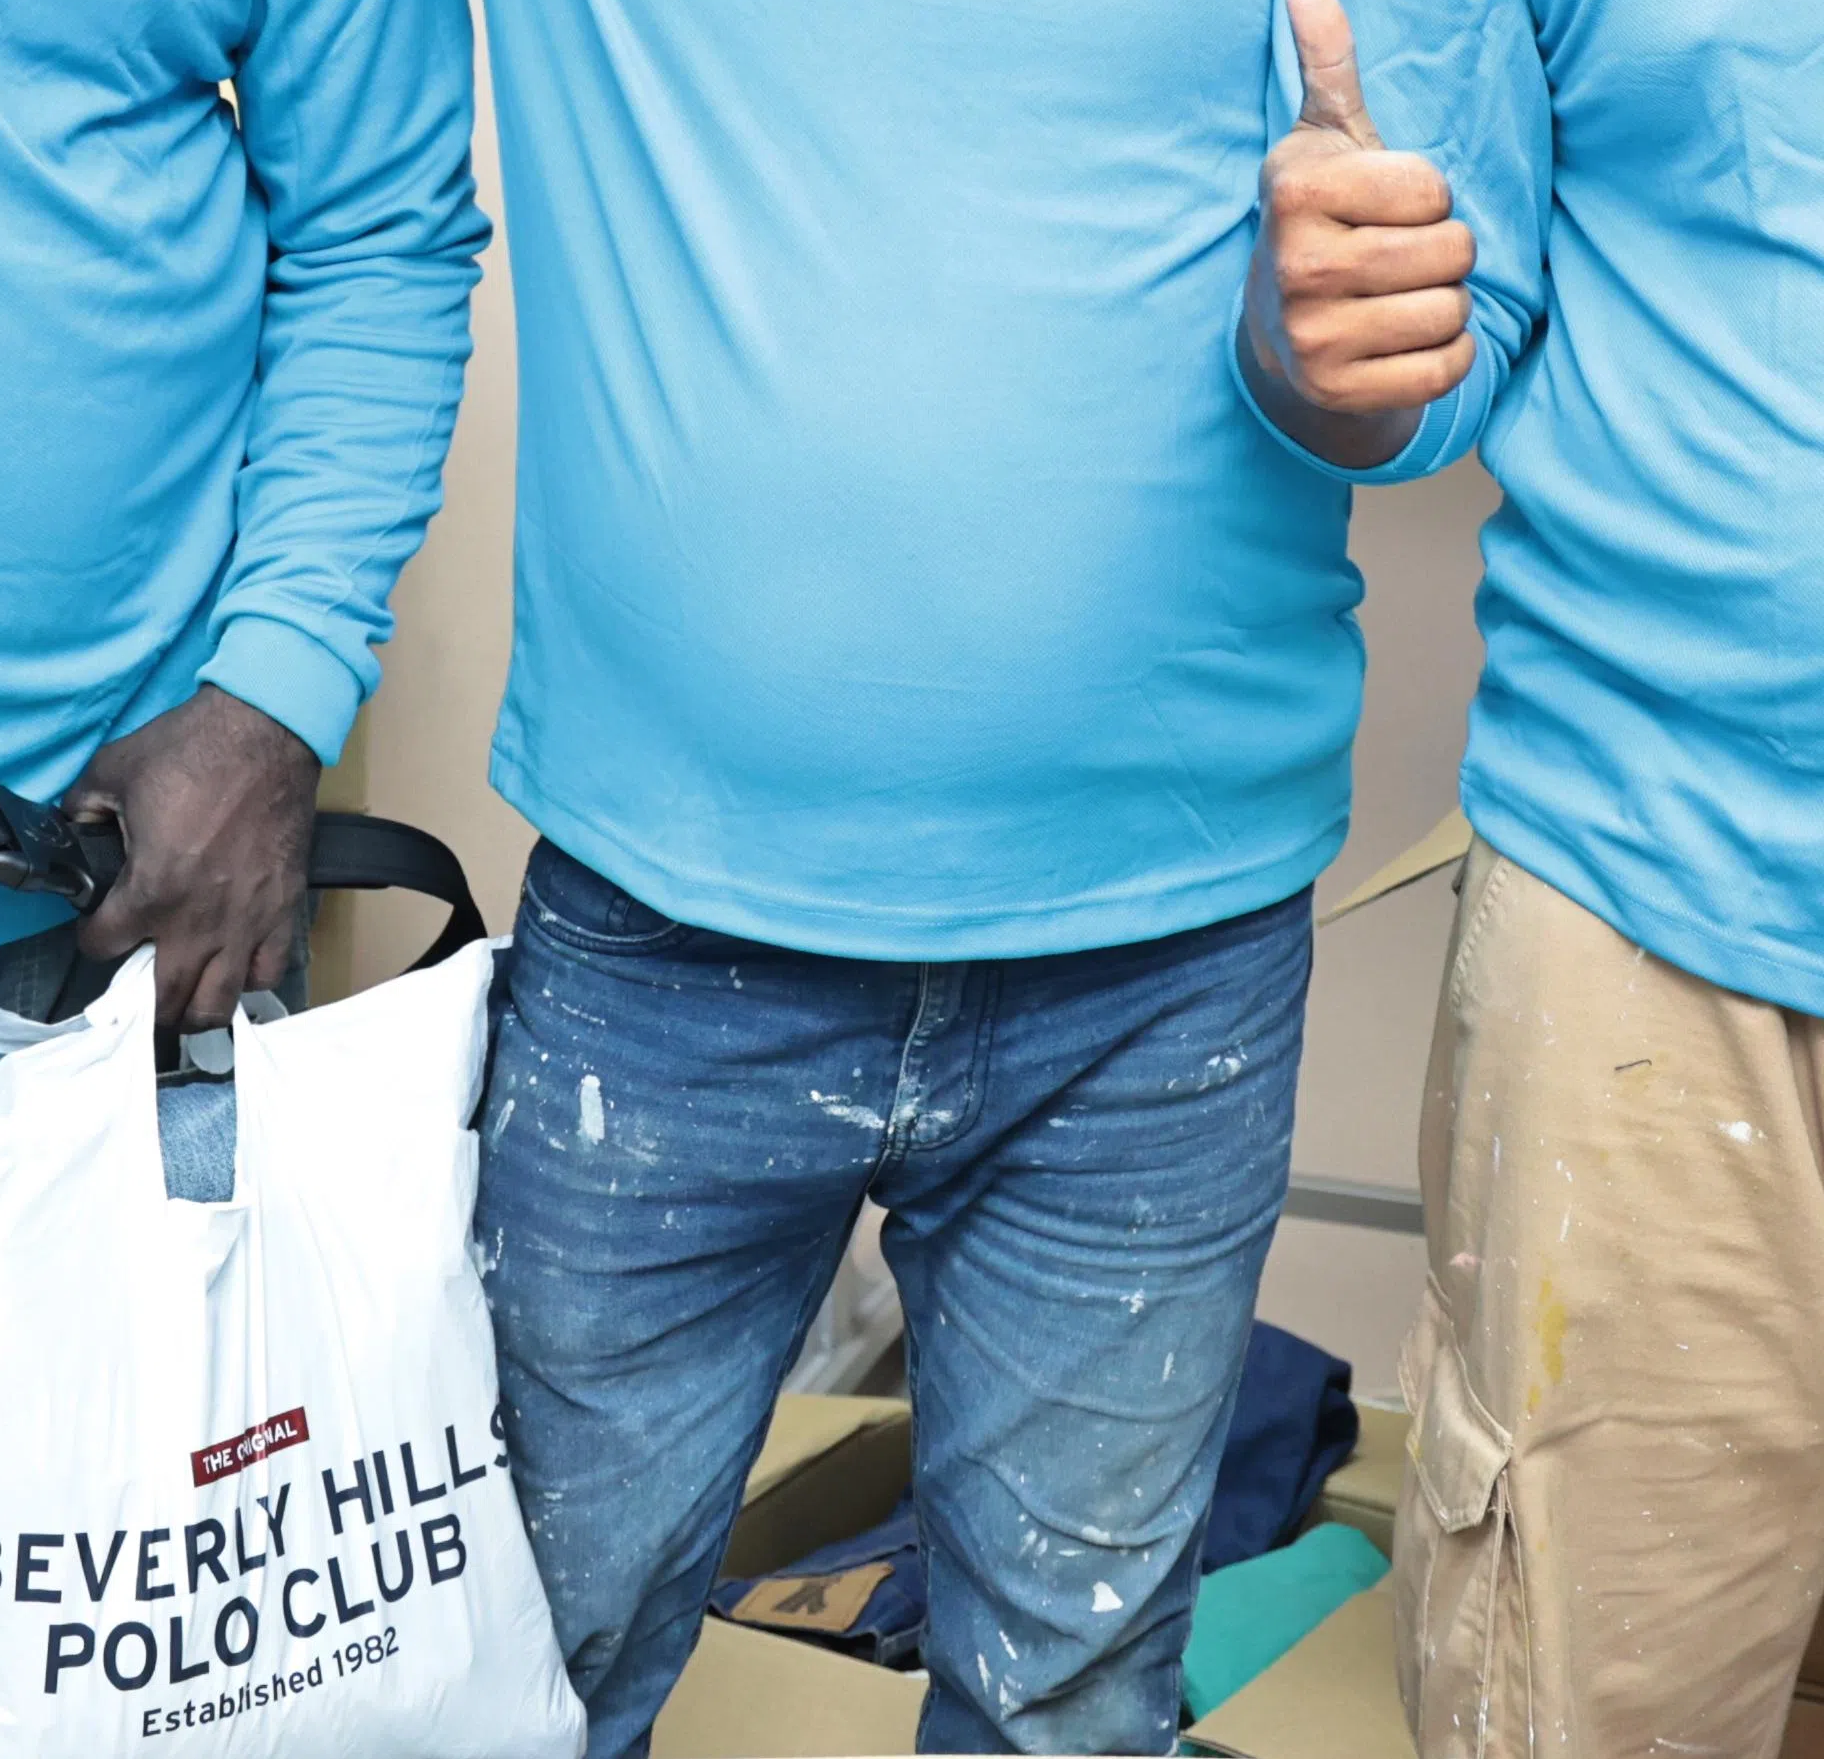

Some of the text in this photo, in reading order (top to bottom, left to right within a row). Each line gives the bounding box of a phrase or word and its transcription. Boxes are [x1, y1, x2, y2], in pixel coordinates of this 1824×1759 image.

[202, 1448, 234, 1475] THE
[44, 1513, 467, 1693] POLO CLUB
[142, 1626, 400, 1737] Established 1982
